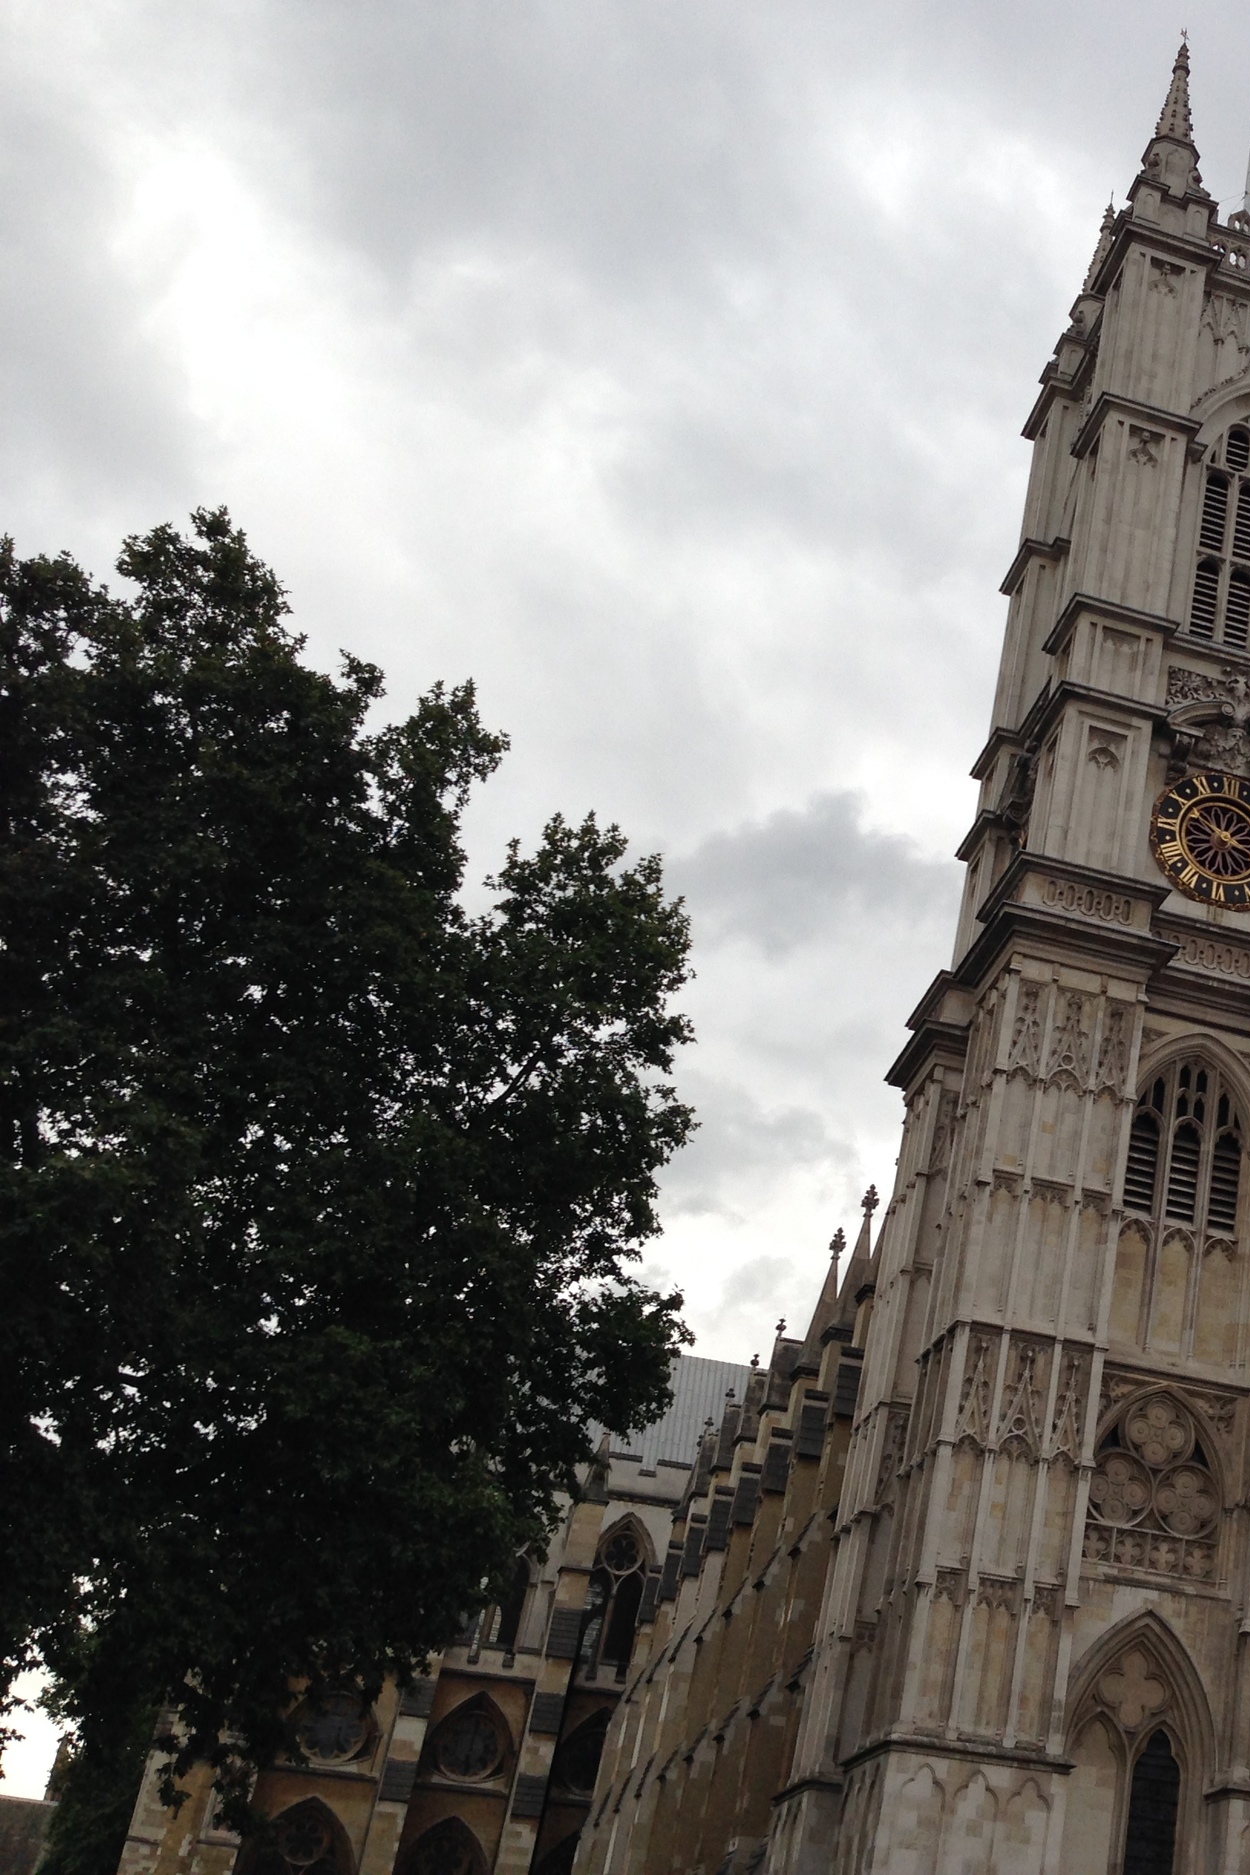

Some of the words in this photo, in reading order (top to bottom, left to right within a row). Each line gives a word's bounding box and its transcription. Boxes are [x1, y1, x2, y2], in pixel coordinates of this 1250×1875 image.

[1192, 776, 1211, 796] XI
[1223, 777, 1240, 798] XII
[1168, 790, 1189, 808] X
[1157, 814, 1177, 832] IX
[1160, 841, 1183, 865] VIII
[1179, 866, 1200, 889] VII
[1211, 881, 1225, 902] VI
